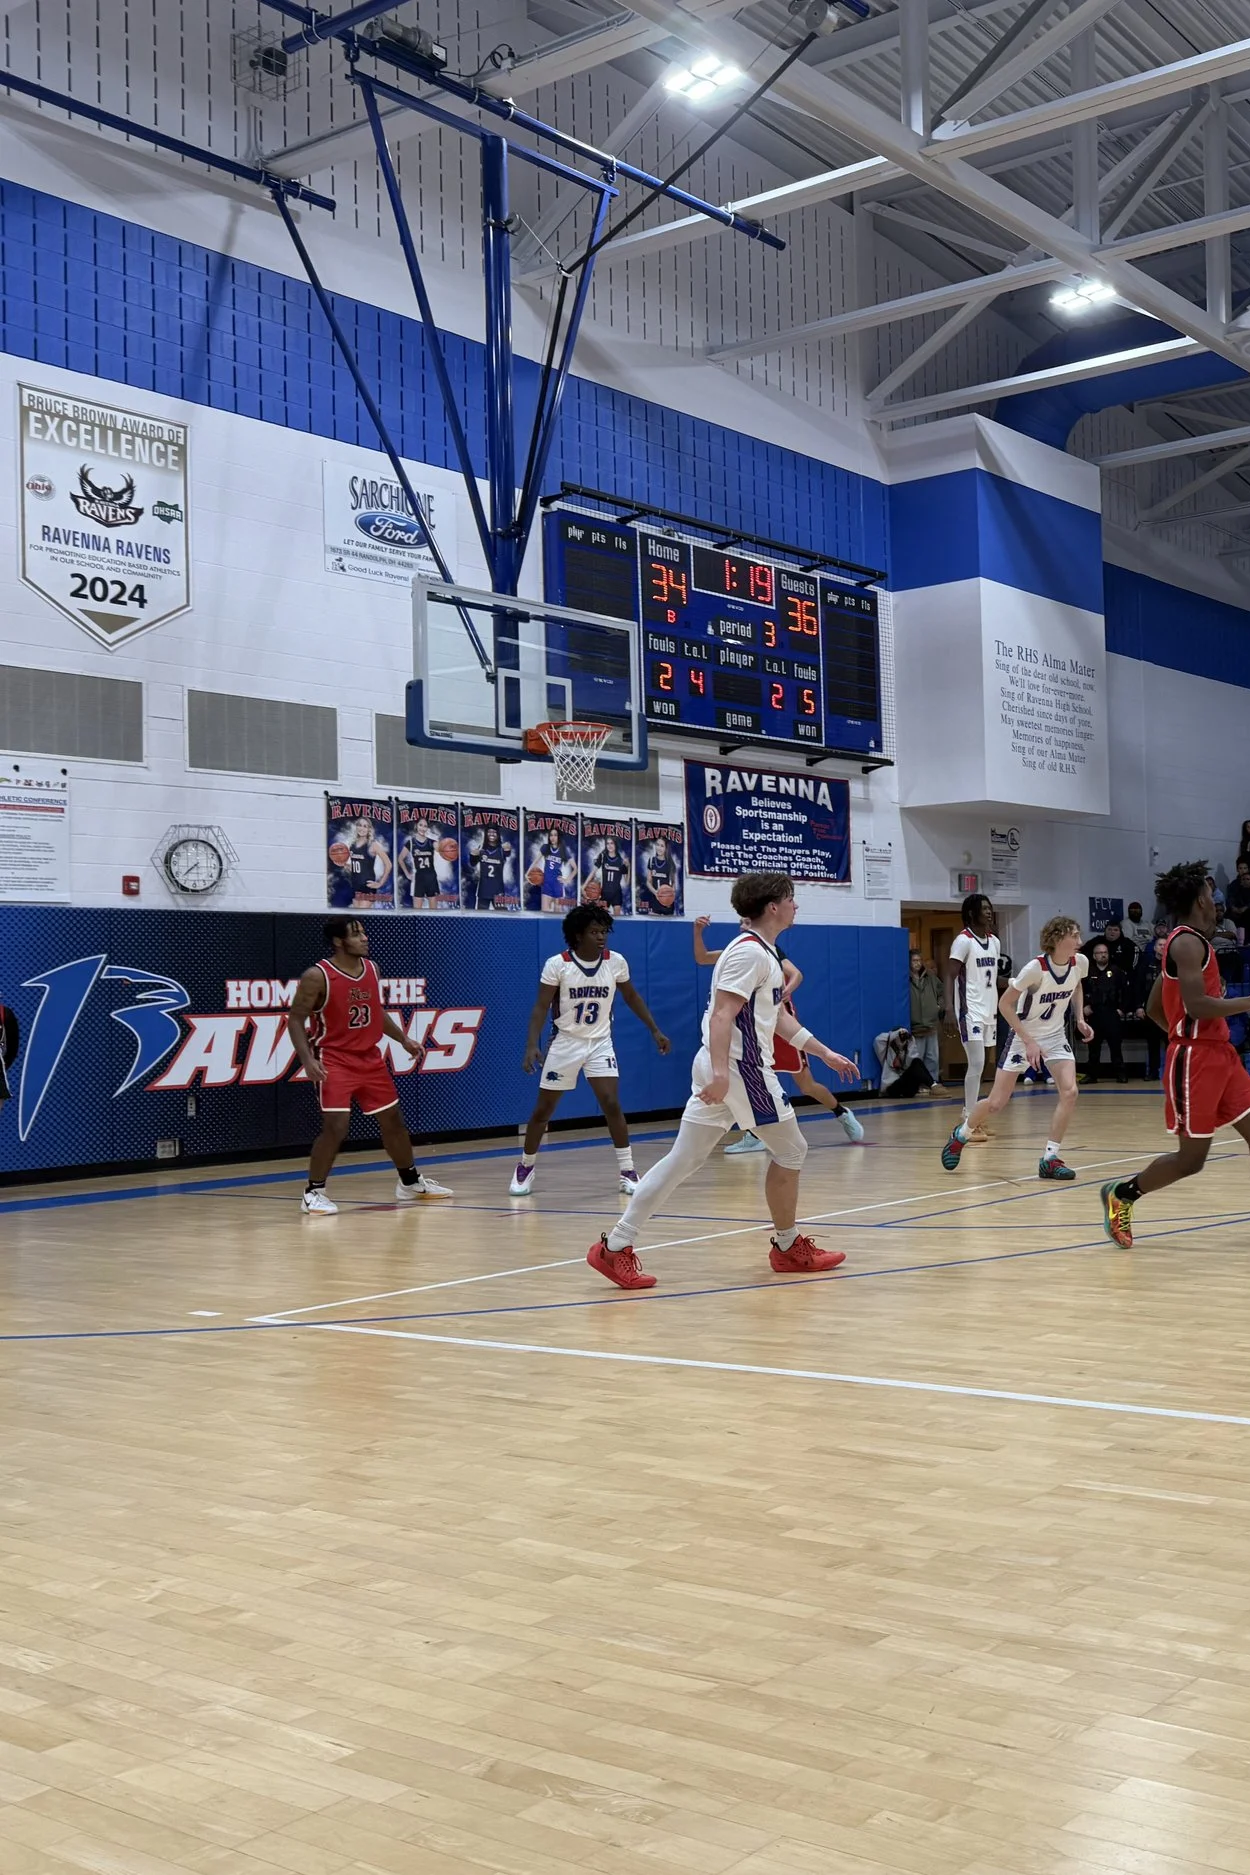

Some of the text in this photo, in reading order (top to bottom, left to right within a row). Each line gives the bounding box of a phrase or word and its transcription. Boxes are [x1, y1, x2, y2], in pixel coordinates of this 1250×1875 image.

[28, 393, 182, 442] BRUCE BROWN AWARD OF
[28, 411, 180, 471] EXCELLENCE
[79, 500, 136, 523] RAVENS
[154, 505, 182, 520] OHSAA
[370, 516, 418, 544] Ford
[42, 525, 171, 565] RAVENNA RAVENS
[355, 540, 368, 548] OUR
[368, 543, 388, 552] FAMILY
[389, 548, 406, 556] SERVE
[407, 551, 422, 560] YOUR
[648, 538, 680, 562] Home
[30, 544, 180, 577] FOR PROMOTING EDUCATION BASED ATHLETICS
[60, 558, 74, 566] OUR
[76, 560, 104, 571] SCHOOL
[106, 564, 121, 573] AND
[122, 568, 162, 581] COMMUNITY
[348, 564, 368, 574] Good
[368, 567, 383, 576] Luck
[384, 571, 409, 582] Ravens!
[724, 559, 772, 602] 1:19
[70, 572, 148, 609] 2024
[652, 563, 687, 605] 34
[781, 573, 816, 596] Guests
[787, 596, 817, 636] 36
[720, 619, 752, 638] period
[764, 621, 776, 648] 3
[648, 634, 676, 654] fouls
[720, 648, 754, 668] player
[995, 640, 1096, 678] The RHS Alma Mater
[660, 662, 672, 690] 2
[690, 670, 704, 695] 4
[794, 663, 816, 682] fouls
[772, 683, 784, 710] 2
[803, 689, 816, 714] 5
[652, 700, 676, 716] won
[726, 711, 752, 728] game
[798, 724, 817, 738] won
[704, 768, 834, 812] RAVENNA
[751, 797, 792, 810] Believes
[331, 804, 392, 824] RAVENS
[400, 807, 457, 827] RAVENS
[464, 812, 518, 832] RAVENS
[736, 806, 808, 823] Sportsmanship
[528, 818, 577, 836] RAVENS
[584, 823, 632, 841] RAVENS
[638, 828, 682, 844] RAVENS
[760, 820, 784, 832] is an
[742, 830, 802, 844] Expectation!
[710, 842, 832, 859] Please Let The Players Play,
[720, 850, 824, 864] Let The Coaches Coach,
[352, 861, 361, 874] 10
[418, 858, 430, 869] 24
[488, 865, 495, 878] 2
[704, 864, 837, 880] Let The Be Positive!
[716, 858, 730, 866] Let
[732, 858, 749, 866] The
[752, 859, 788, 869] Officials
[1094, 898, 1112, 910] FLY
[986, 970, 992, 988] 2
[225, 979, 301, 1008] HOM
[568, 986, 610, 999] RAVENS
[1040, 990, 1073, 1004] RAVENS
[348, 1004, 370, 1028] 23
[574, 1002, 600, 1025] 13
[1040, 1003, 1056, 1020] 0
